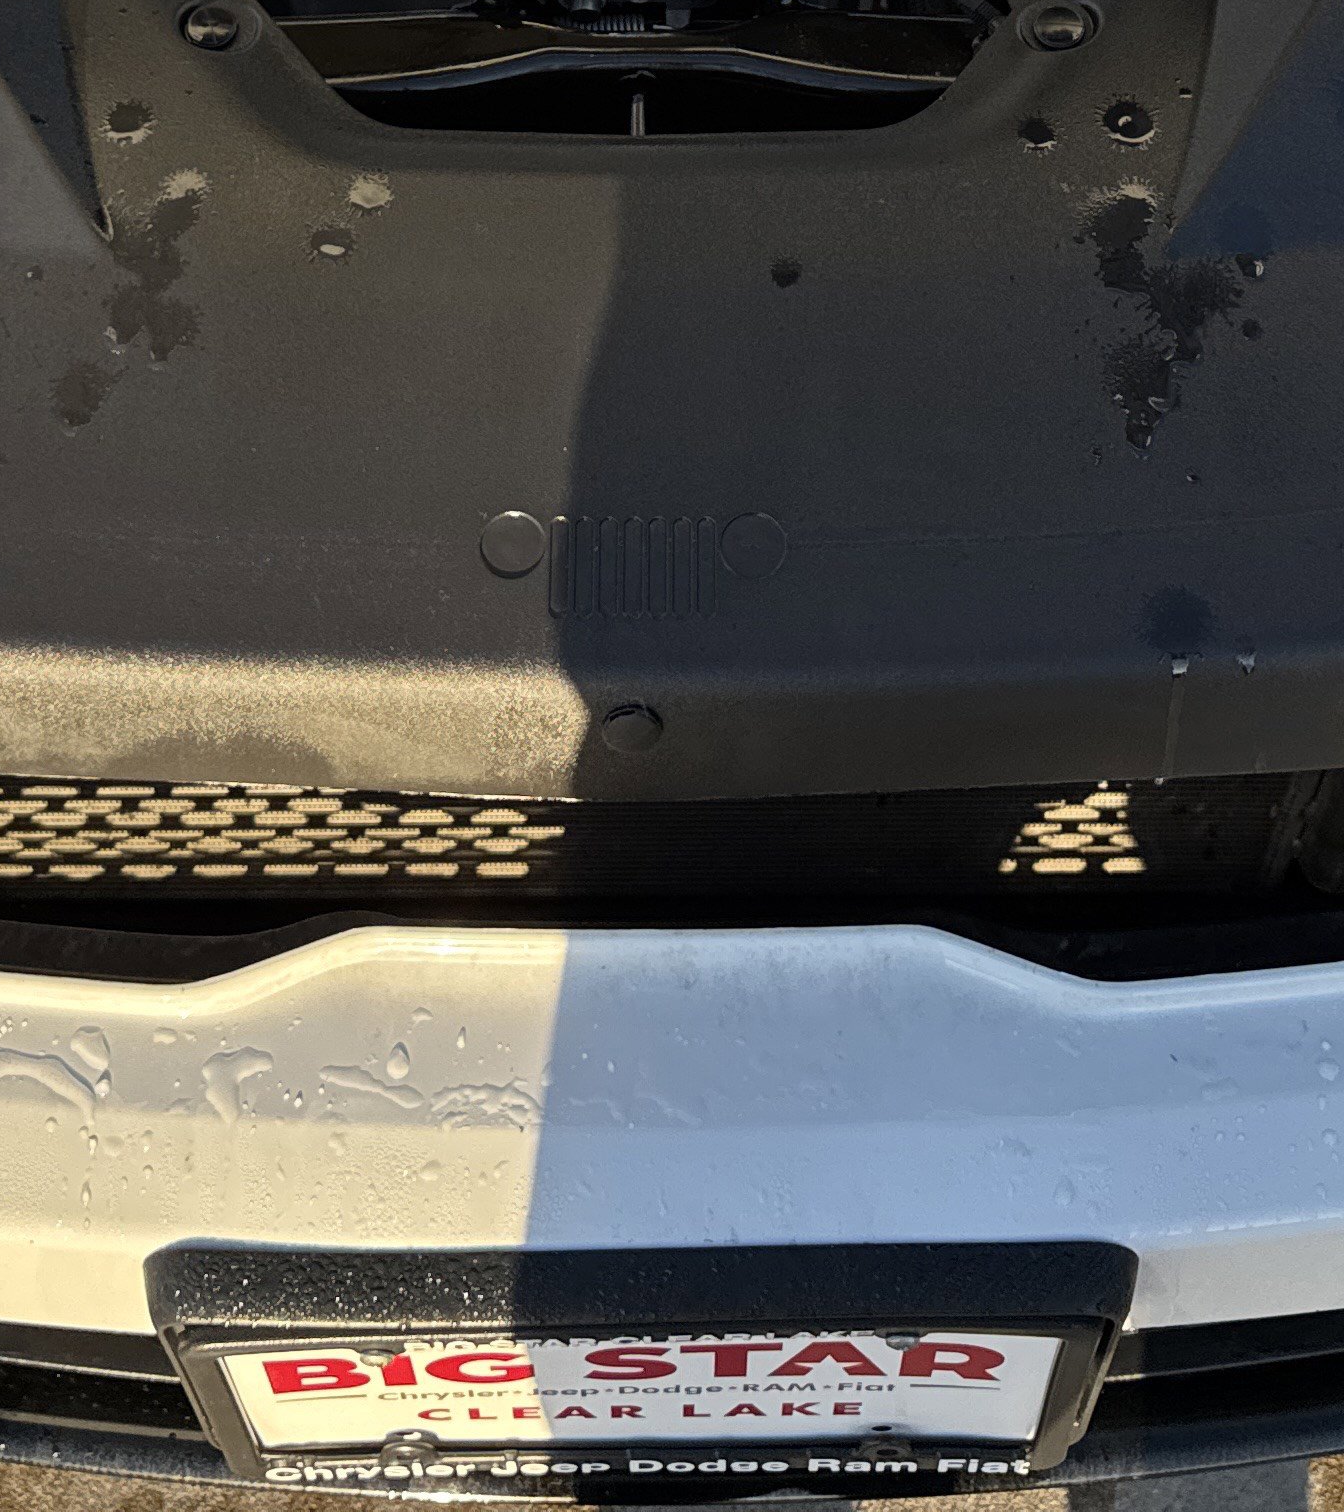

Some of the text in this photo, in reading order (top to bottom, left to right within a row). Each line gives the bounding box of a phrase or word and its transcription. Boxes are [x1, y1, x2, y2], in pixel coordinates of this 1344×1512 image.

[262, 1340, 1006, 1395] BIG STAR
[378, 1382, 896, 1402] Chrysler Jeep Dodge RAM Fiat
[417, 1402, 864, 1421] CLEAR LAKE
[264, 1457, 1031, 1482] Chrysler Jeep Dodge Ram Fiat
